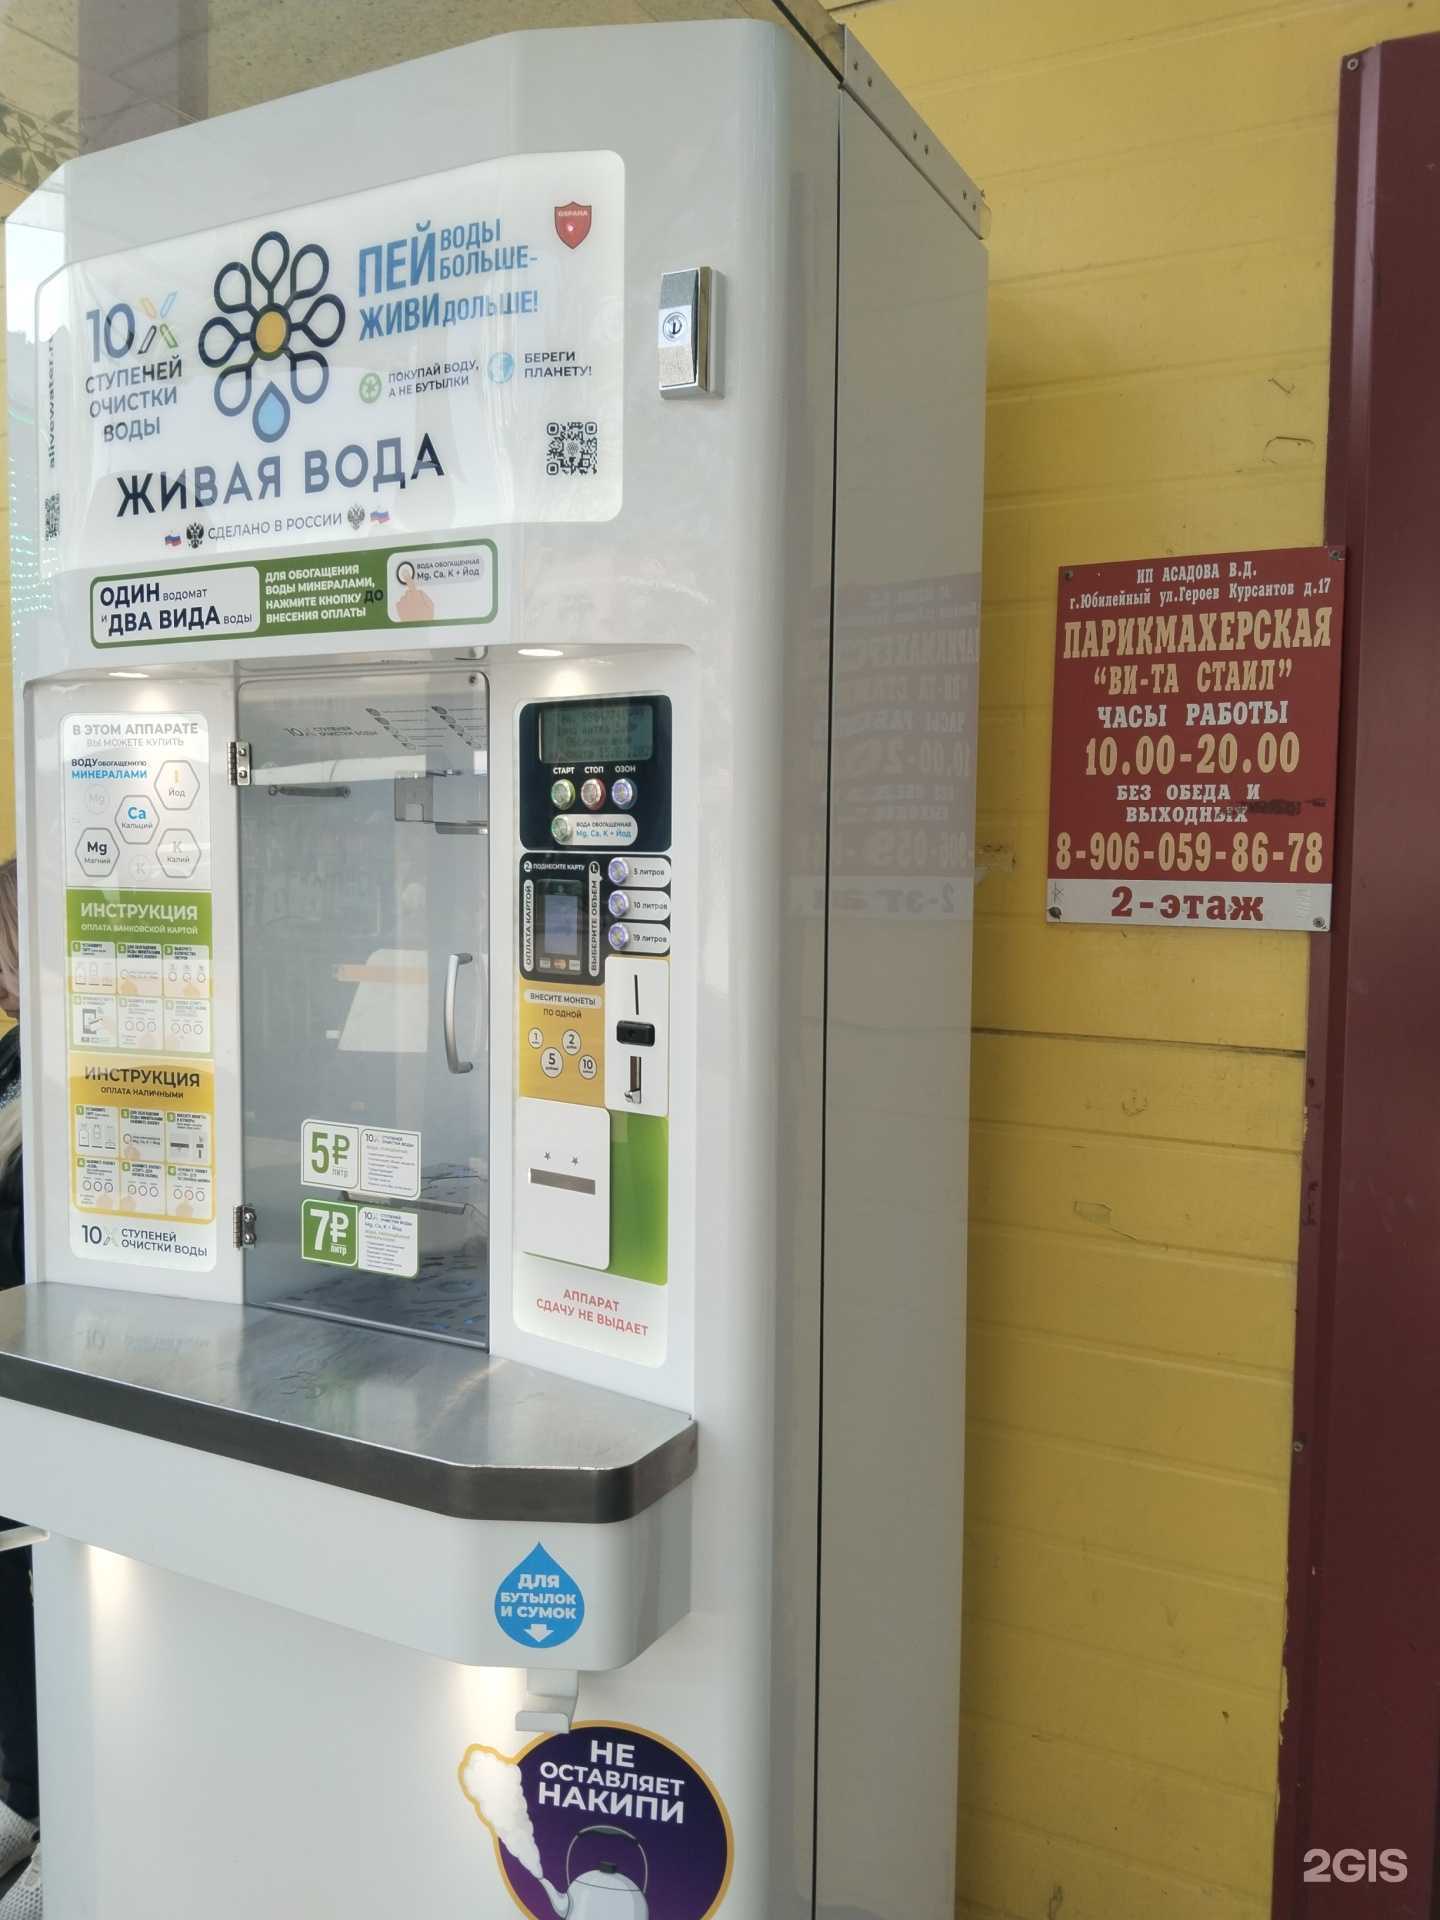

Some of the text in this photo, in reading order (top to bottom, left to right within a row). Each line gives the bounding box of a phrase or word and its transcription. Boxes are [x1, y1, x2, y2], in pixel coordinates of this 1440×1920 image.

[358, 219, 500, 297] ПЕЙ ВОДЫ
[440, 245, 538, 280] БОЛЬШЕ-
[359, 293, 439, 341] ЖИВИ
[86, 303, 135, 362] 10
[525, 351, 576, 363] БЕРЕГИ
[85, 355, 182, 394] СТУПЕНЕЙ
[389, 360, 479, 383] ПОКУПАЙ ВОДУ,
[525, 366, 592, 378] ПЛАНЕТУ!
[389, 375, 469, 398] А НЕ БУТЫЛКИ
[90, 387, 177, 418] ОЧИСТКИ
[104, 418, 160, 442] ВОДЫ
[117, 432, 445, 517] ЖИВАЯ ВОДА
[208, 513, 342, 540] СДЕЛАНО В РОССИИ
[266, 564, 359, 583] ДЛЯ ОБОГАЩЕНИЯ
[1136, 561, 1257, 584] ИП АСАДОВА В.Д.
[100, 583, 207, 608] ОДИН водомат
[266, 577, 375, 595] ВОДЫ МИНЕРАЛАМИ,
[1070, 577, 1331, 610] г.Юбилейный ул.Героев Курсантов д.17
[266, 590, 383, 609] НАЖМИТЕ КНОПКУ ДО
[108, 611, 152, 636] ДВА
[160, 605, 220, 630] ВИДА
[223, 613, 252, 624] воды
[266, 607, 366, 624] ВНЕСЕНИЯ ОПЛАТЫ
[1063, 606, 1333, 659] ПАРИКМАХЕРСКАЯ
[1097, 700, 1289, 729] ЧАСЫ РАБОТЫ
[73, 723, 198, 735] В ЭТОМ АППАРАТЕ
[146, 738, 184, 746] КУПИТЬ
[72, 758, 97, 767] ВОДУ
[1086, 731, 1300, 776] 10.00-20.00
[72, 770, 147, 779] МИНЕРАЛАМИ
[553, 765, 636, 774] СТАРТ СТОП ОЗОН
[168, 788, 185, 797] Йод
[1116, 783, 1260, 803] БЕЗ ОБЕДА И
[128, 807, 146, 819] Ca
[1126, 806, 1248, 825] ВЫХОДНЫХ
[87, 842, 107, 855] Mg
[1056, 832, 1323, 873] 8-906-059-86-78
[81, 903, 198, 922] ИНСТРУКЦИЯ
[642, 902, 667, 910] литров
[1111, 886, 1264, 921] 2-этаж
[81, 923, 198, 935] ОПЛАТА БАНКОВСКОЙ КАРТОЙ
[641, 935, 667, 943] литров
[530, 992, 596, 1005] ВНЕСИТЕ МОНЕТЫ
[544, 1008, 582, 1019] ПО ОДНОЙ
[569, 1034, 575, 1044] 2
[549, 1053, 555, 1065] 5
[583, 1059, 593, 1069] 10
[85, 1066, 200, 1088] ИНСТРУКЦИЯ
[101, 1086, 184, 1099] ОПЛАТА НАЛИЧНЫМИ
[365, 1134, 374, 1142] 10
[82, 1225, 102, 1244] 10
[121, 1226, 177, 1242] СТУПЕНЕЙ
[121, 1239, 208, 1257] ОЧИСТКИ ВОДЫ
[331, 1244, 347, 1256] литр
[563, 1289, 619, 1312] АППАРАТ
[536, 1298, 648, 1336] СДАЧУ НЕ ВЫДАЕТ
[518, 1573, 560, 1589] ДЛЯ
[500, 1592, 576, 1605] БУТЫЛОК
[501, 1606, 576, 1619] И СУМОК
[590, 1740, 635, 1768] НЕ
[540, 1761, 685, 1797] ОСТАВЛЯЕТ
[538, 1782, 684, 1824] НАКИПИ
